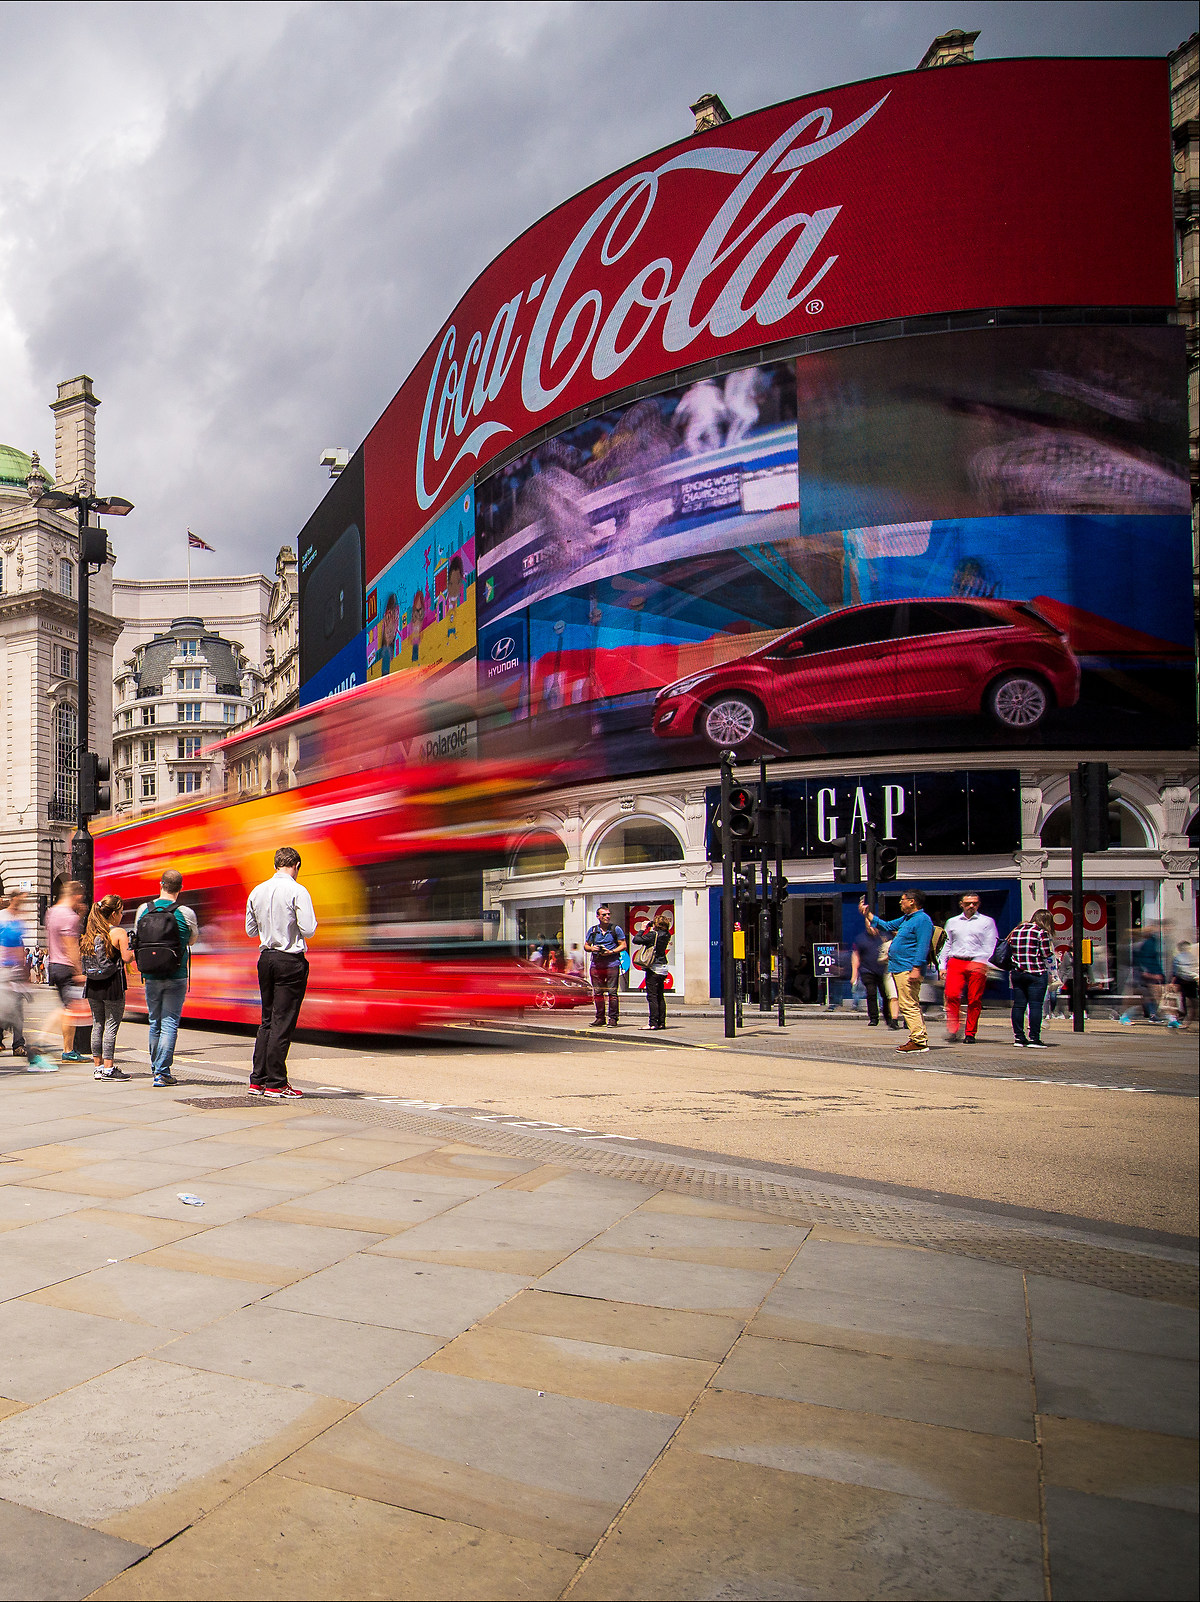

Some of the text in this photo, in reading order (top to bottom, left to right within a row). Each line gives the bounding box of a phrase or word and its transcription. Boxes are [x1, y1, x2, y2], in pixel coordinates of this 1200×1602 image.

[416, 90, 892, 510] Coca-Cola
[41, 621, 76, 640] ALLIANCE LIFE
[488, 657, 519, 678] HYUNDAI
[426, 724, 468, 760] Polaroid
[817, 784, 905, 843] GAP
[1047, 895, 1108, 931] 60
[471, 1114, 639, 1141] LEFT
